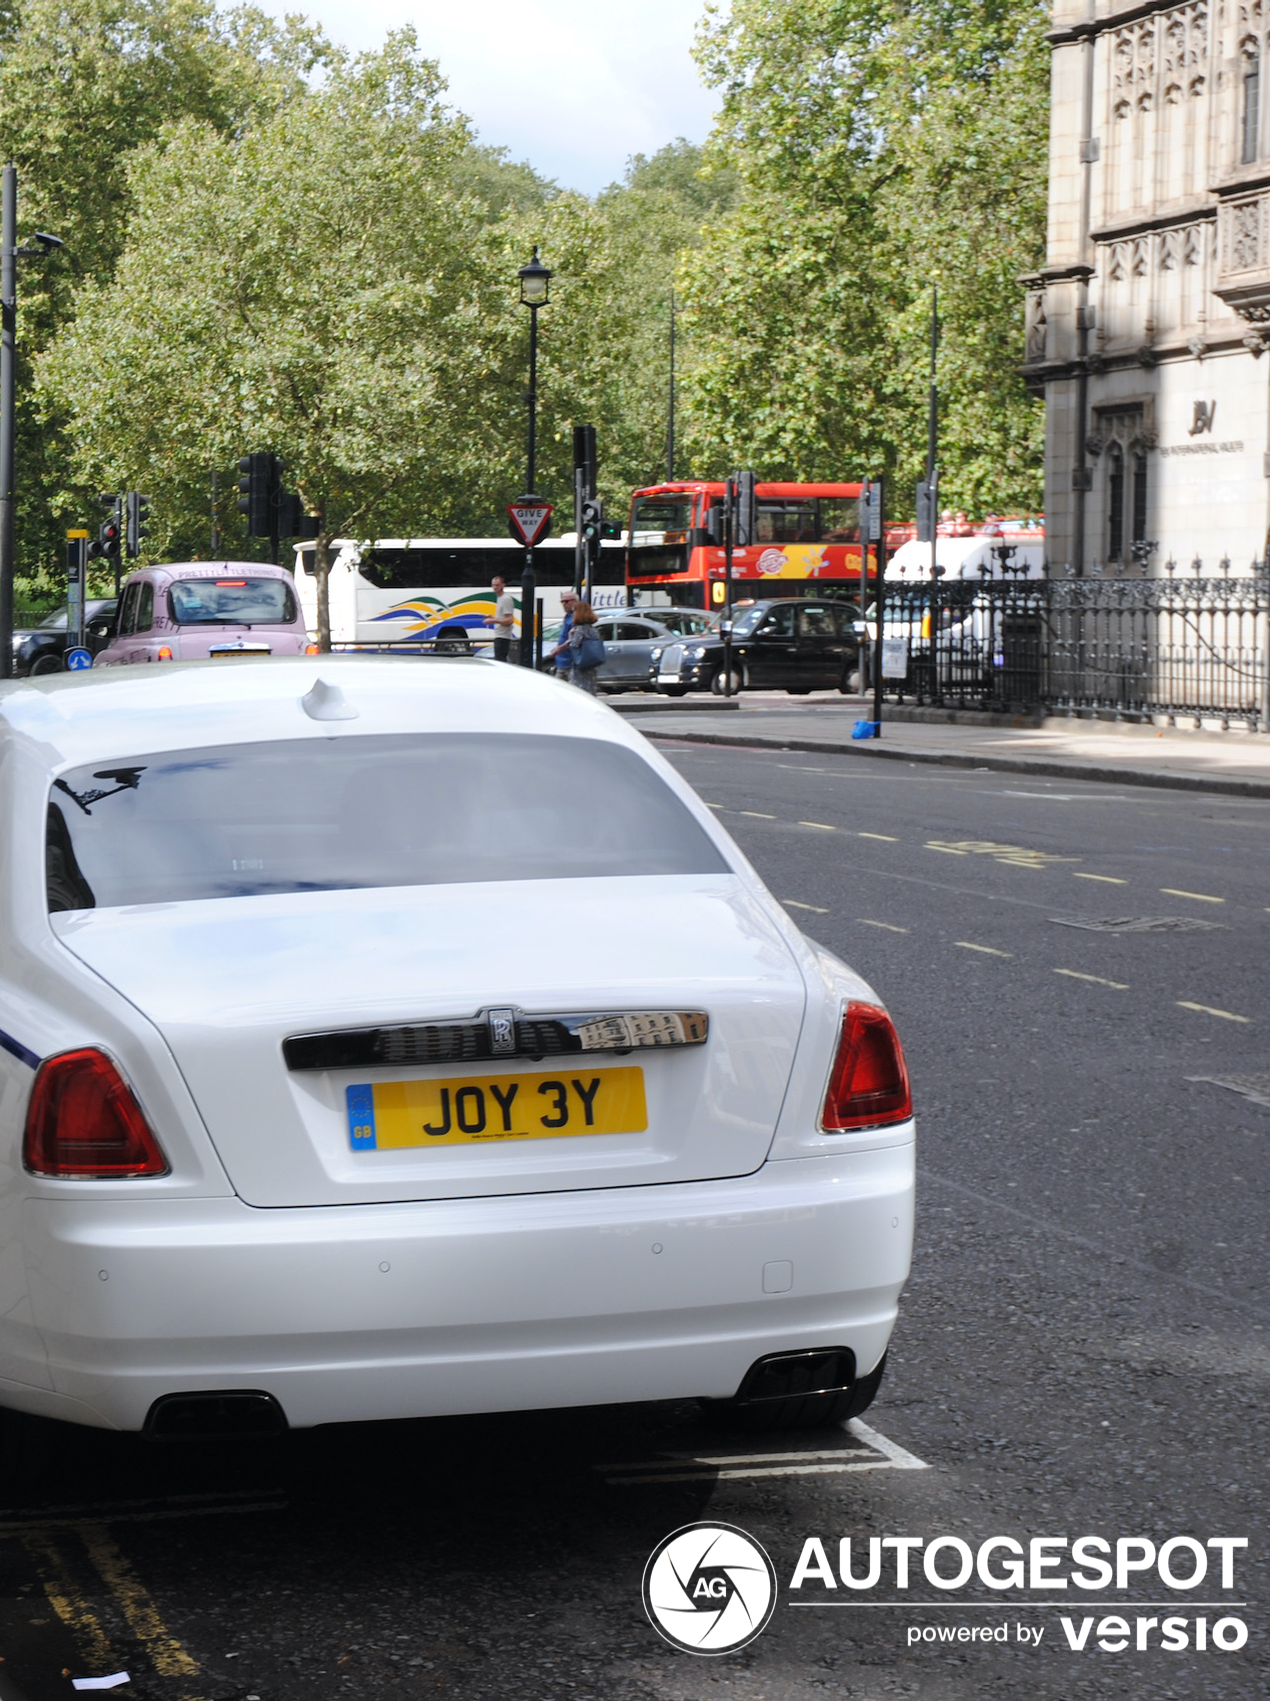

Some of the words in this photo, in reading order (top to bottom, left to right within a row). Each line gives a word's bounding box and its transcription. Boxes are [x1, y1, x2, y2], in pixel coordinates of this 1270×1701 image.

[516, 509, 542, 517] GIVE
[423, 1083, 519, 1136] JOY
[537, 1077, 601, 1128] 3Y
[354, 1125, 372, 1138] GB
